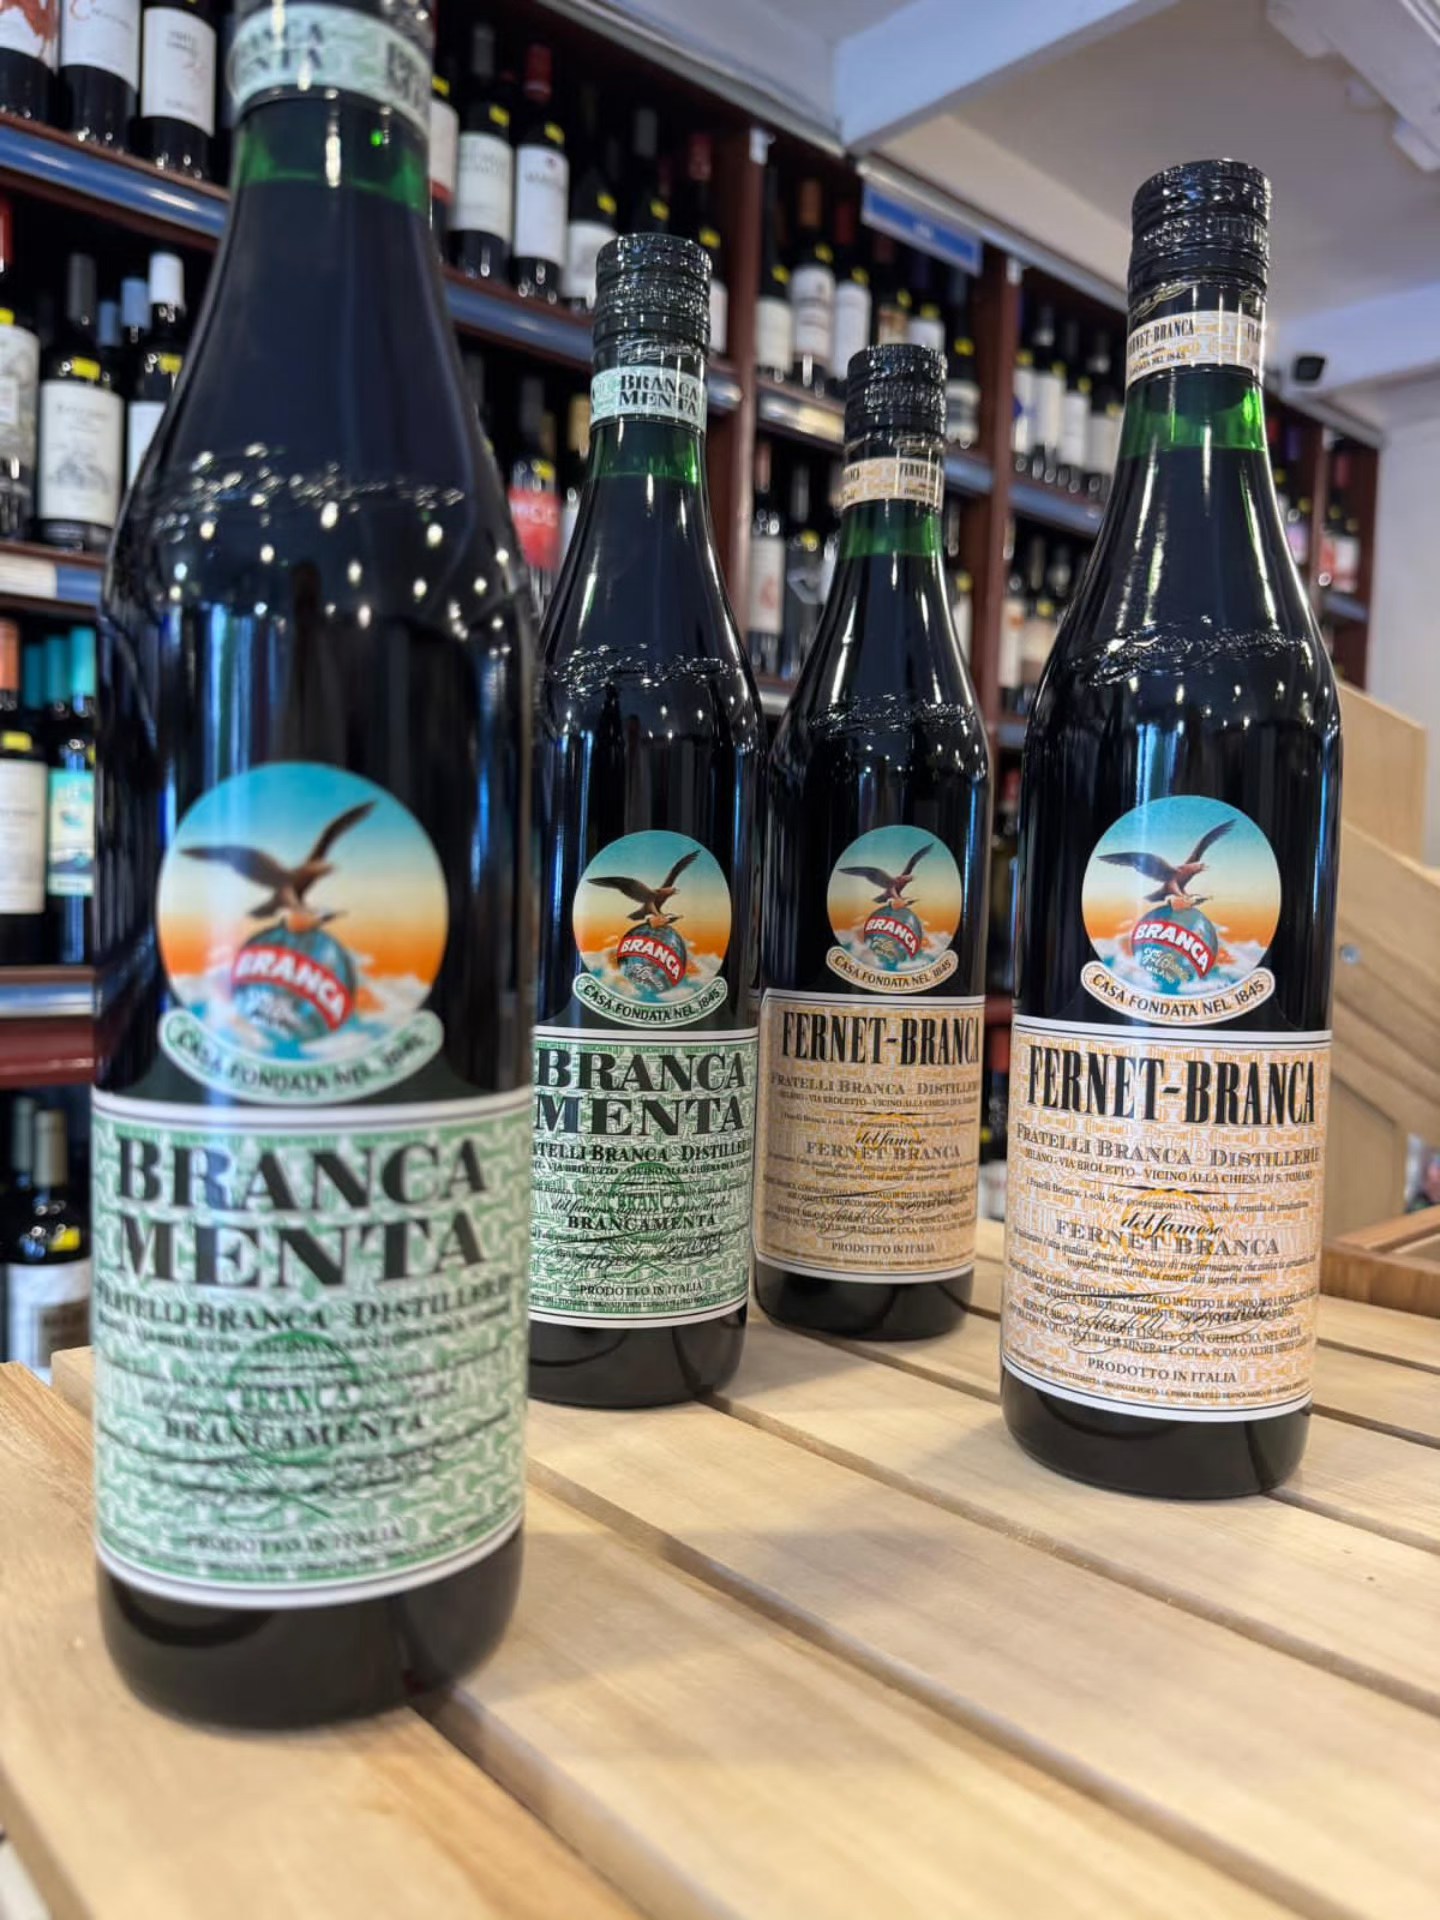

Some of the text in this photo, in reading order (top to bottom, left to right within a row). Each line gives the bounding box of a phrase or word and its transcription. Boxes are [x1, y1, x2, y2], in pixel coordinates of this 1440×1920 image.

[619, 391, 698, 417] MENTA
[620, 374, 698, 400] BRANCA
[865, 918, 916, 954] BRANCA
[1134, 923, 1211, 973] BRANCA
[620, 939, 680, 980] BRANCA
[834, 955, 860, 977] CASA
[861, 971, 909, 987] FONDATA
[912, 973, 931, 985] NEL
[237, 951, 345, 1018] BRANCA
[1092, 973, 1266, 1018] CASA FONDATA NEL 1845
[583, 984, 720, 1022] CASA FONDATA NEL 1845
[782, 1011, 979, 1066] FERNET-BRANCA
[536, 1048, 746, 1093] BRANCA
[769, 1071, 834, 1092] FRATELLI
[840, 1080, 905, 1095] BRANCA
[1028, 1044, 1315, 1126] FERNET-BRANCA
[535, 1095, 744, 1136] MENTA
[592, 1144, 668, 1161] BRANCA
[806, 1140, 961, 1161] FERNET BRANCA
[1017, 1123, 1092, 1154] FRATELLI
[1097, 1138, 1192, 1165] BRANCA
[118, 1137, 487, 1212] BRANCA
[1058, 1157, 1075, 1169] VIA
[1077, 1160, 1136, 1178] BROLETTO
[1145, 1170, 1188, 1182] VICINO
[1190, 1171, 1219, 1183] ALLA
[1221, 1172, 1261, 1184] CHIESA
[568, 1214, 716, 1231] BRANCAMENTA
[1056, 1218, 1171, 1252] FERNET
[1175, 1237, 1280, 1256] BRANCA
[1120, 1212, 1224, 1237] del famoso
[117, 1210, 487, 1287] MENTA
[832, 1241, 890, 1255] PRODOTTO
[580, 1282, 703, 1296] PRODOTTO IN ITALIA
[198, 1303, 327, 1332] BRANCA
[1087, 1356, 1237, 1383] PRODOTTO IN ITALIA
[165, 1412, 424, 1451] BRANCAMENTA
[185, 1531, 300, 1554] PRODOTTO
[331, 1523, 401, 1550] ITALIA
